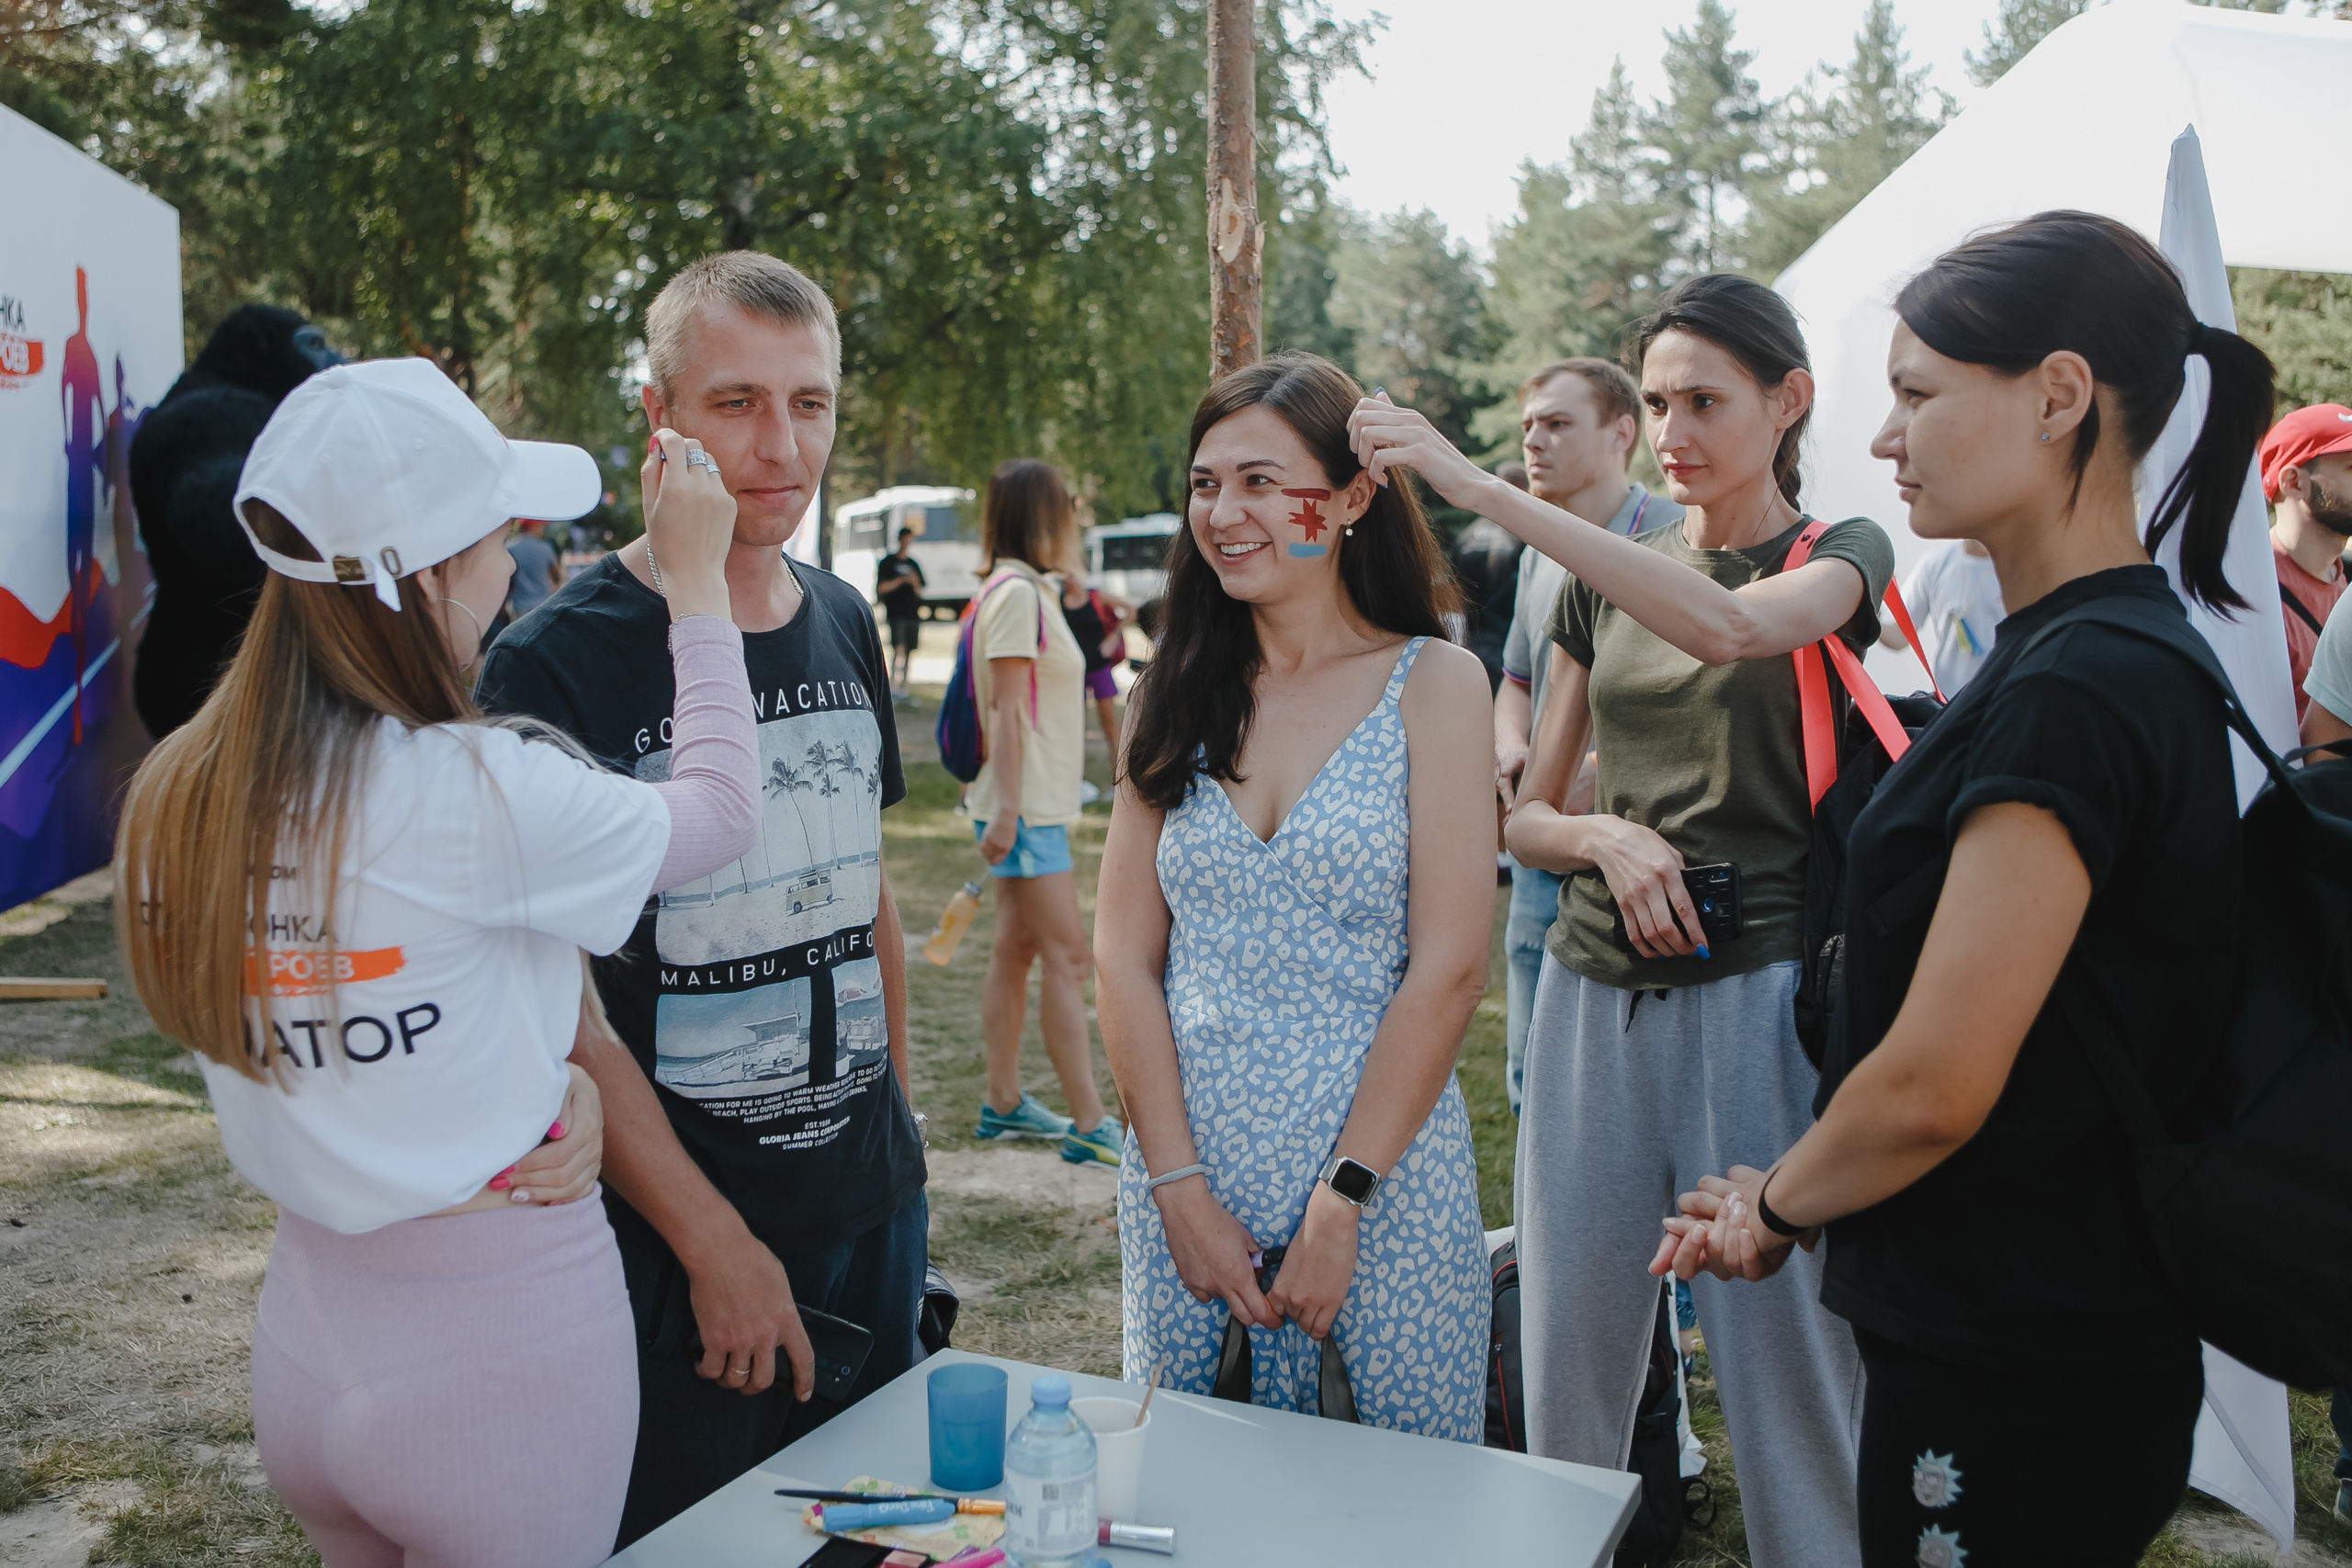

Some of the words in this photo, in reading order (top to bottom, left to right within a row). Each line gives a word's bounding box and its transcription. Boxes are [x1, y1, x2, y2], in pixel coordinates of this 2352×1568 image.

[634, 716, 673, 754] GO
[752, 680, 873, 719] VACATION
[661, 958, 787, 987] MALIBU,
[243, 1002, 441, 1068] АТОР
[726, 1100, 741, 1109] FOR
[742, 1099, 753, 1108] ME
[763, 1093, 783, 1105] GOING
[792, 1086, 814, 1097] WARM
[857, 1069, 865, 1077] TO
[865, 1066, 874, 1075] GO
[740, 1107, 758, 1116] PLAY
[759, 1101, 786, 1113] OUTSIDE
[813, 1092, 833, 1102] BEING
[855, 1077, 873, 1086] GOING
[743, 1113, 774, 1123] HANGING
[774, 1111, 783, 1119] BY
[784, 1107, 796, 1115] THE
[797, 1103, 817, 1113] POOL,
[818, 1099, 837, 1111] HAVING
[758, 1133, 791, 1145] GLORIA
[792, 1129, 820, 1141] JEANS
[782, 1140, 813, 1150] SUMMER
